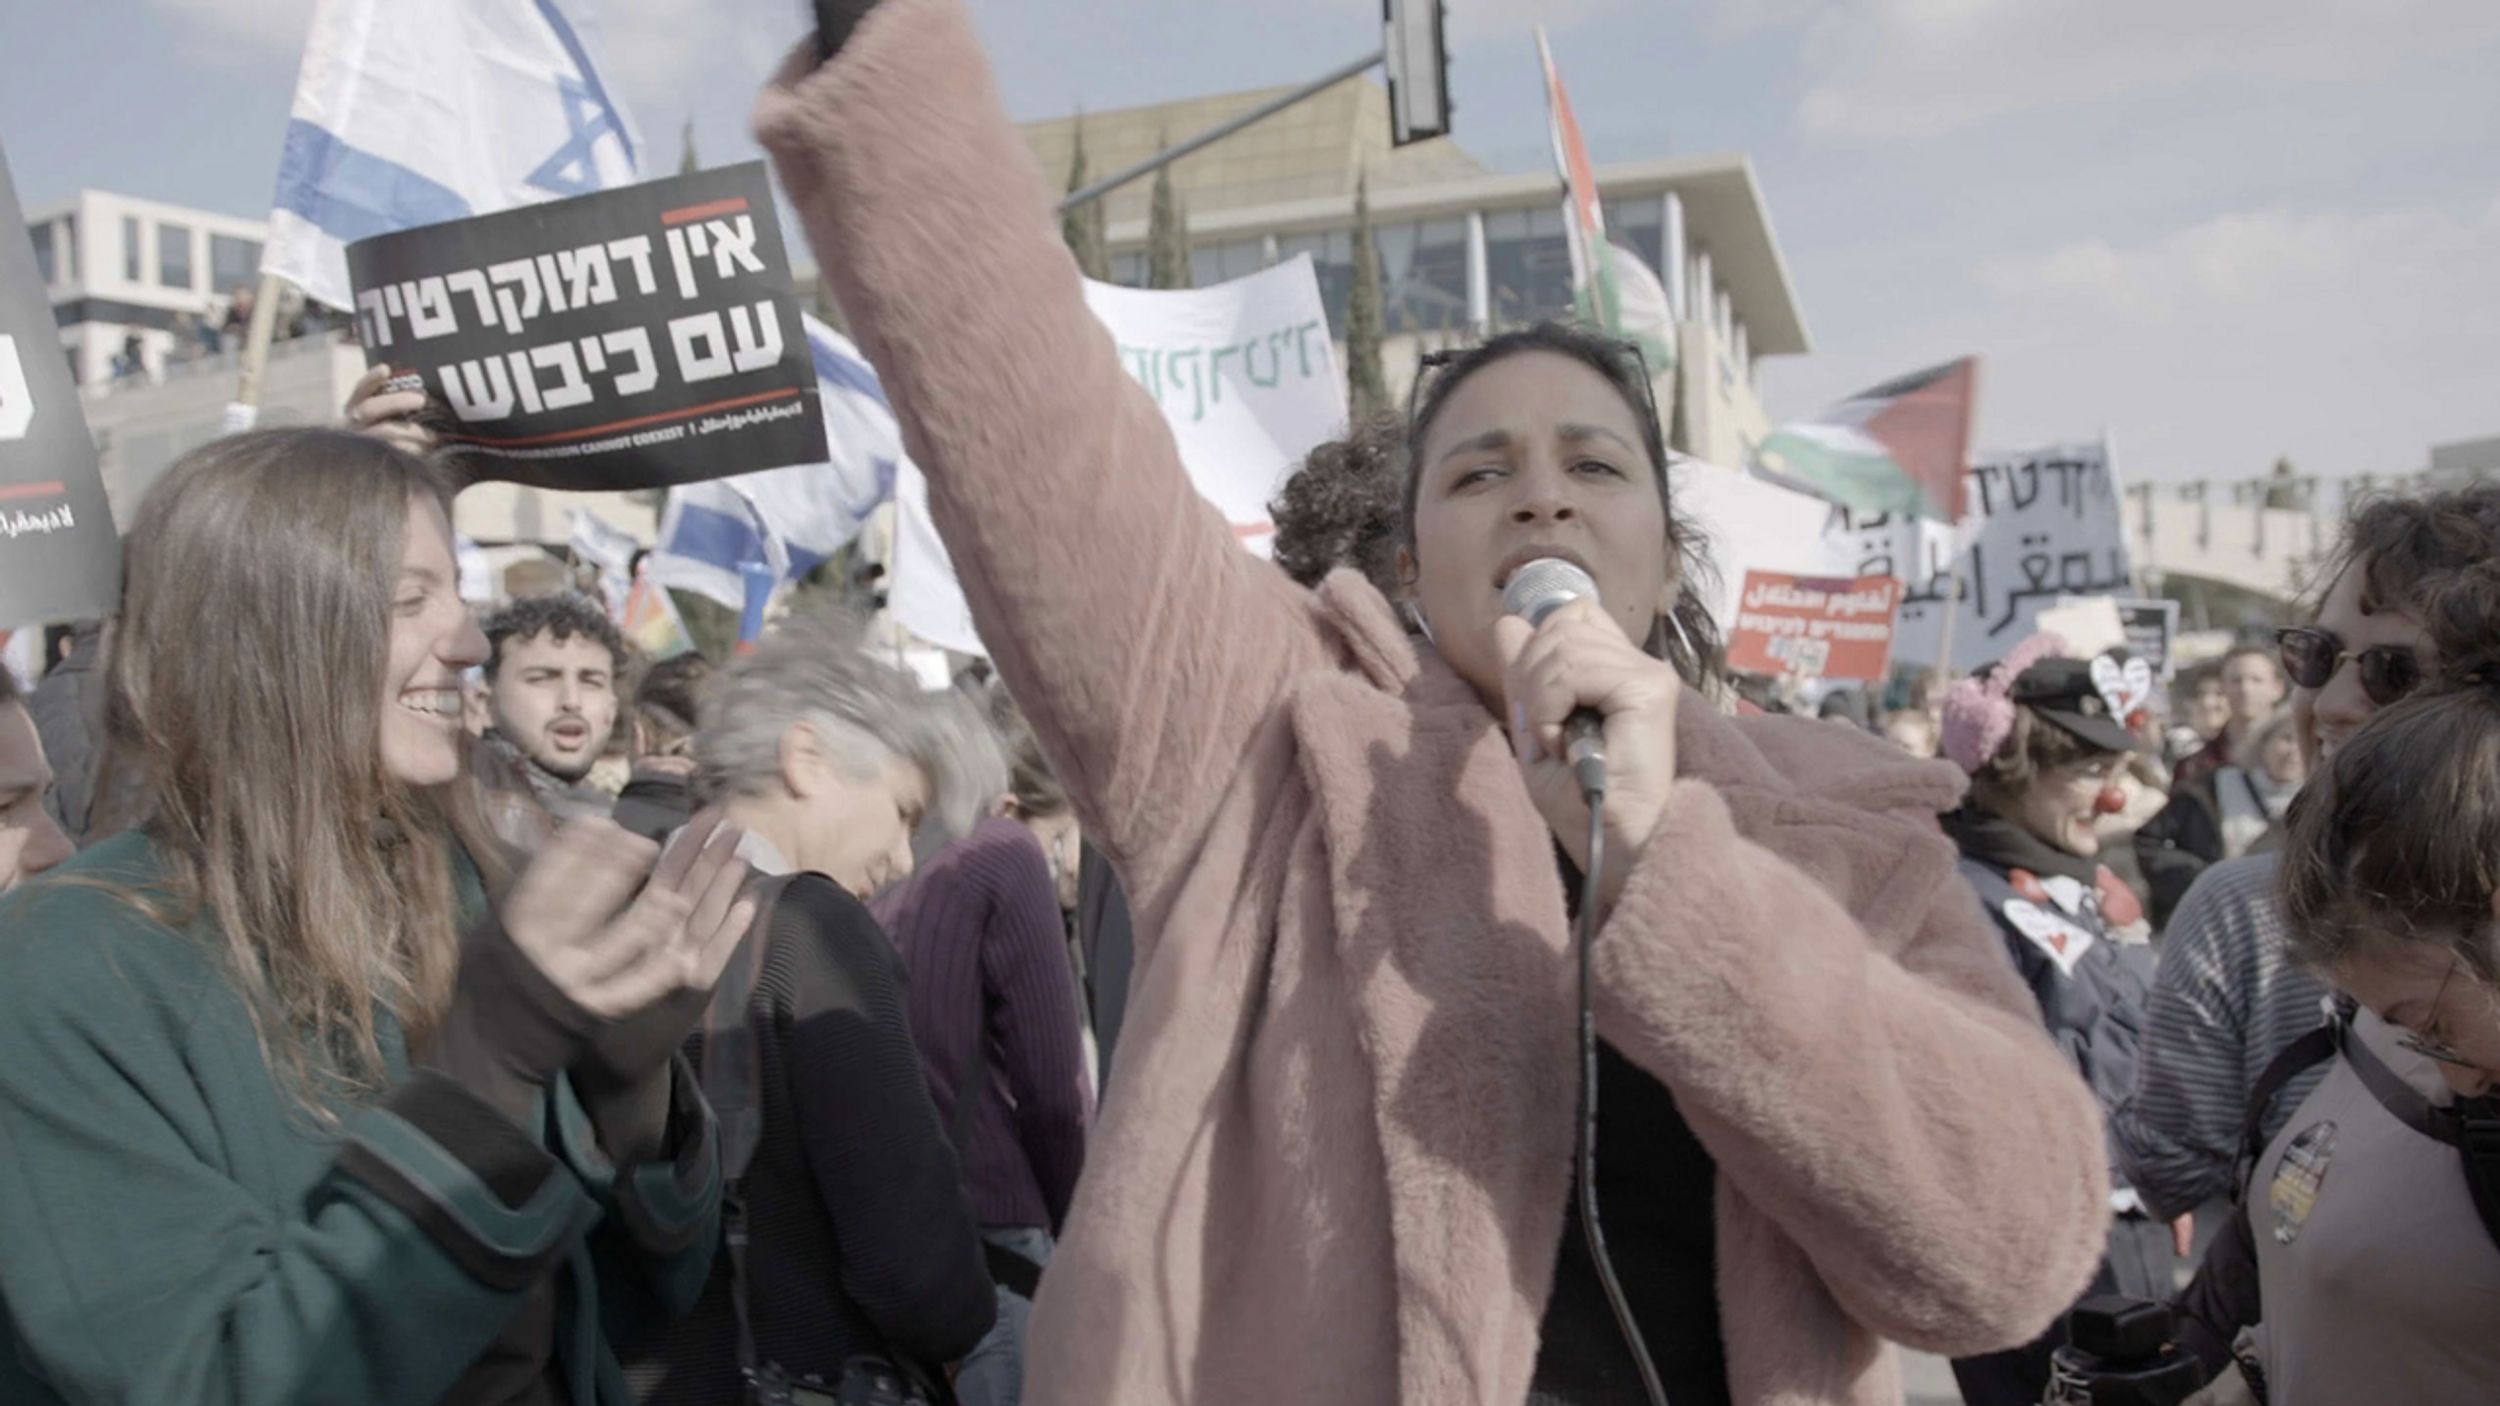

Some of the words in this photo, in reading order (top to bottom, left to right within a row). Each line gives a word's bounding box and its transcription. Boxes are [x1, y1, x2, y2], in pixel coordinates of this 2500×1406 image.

[358, 235, 656, 348] דמוקרטיה
[664, 214, 765, 300] אין
[437, 326, 659, 423] כיבוש
[667, 299, 785, 384] עם
[580, 434, 631, 455] CANNOT
[632, 427, 685, 446] COEXIST
